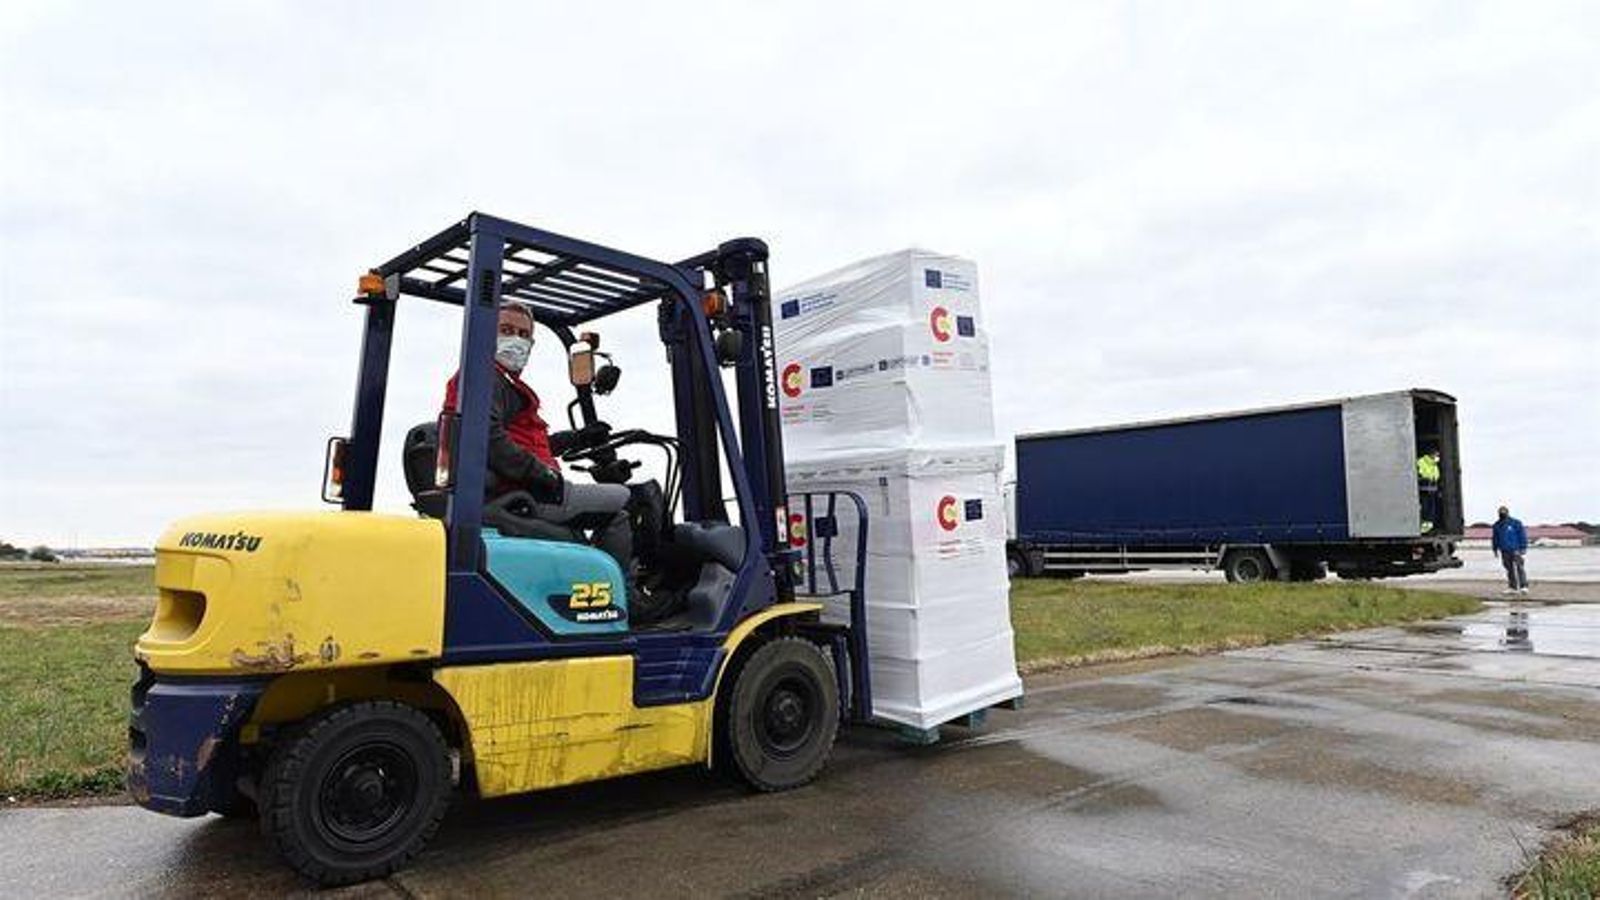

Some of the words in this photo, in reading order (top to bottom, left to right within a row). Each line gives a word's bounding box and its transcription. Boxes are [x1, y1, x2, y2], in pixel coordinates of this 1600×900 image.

[760, 325, 776, 409] KOMATSU
[179, 531, 262, 553] KOMATSU
[570, 583, 611, 609] 25
